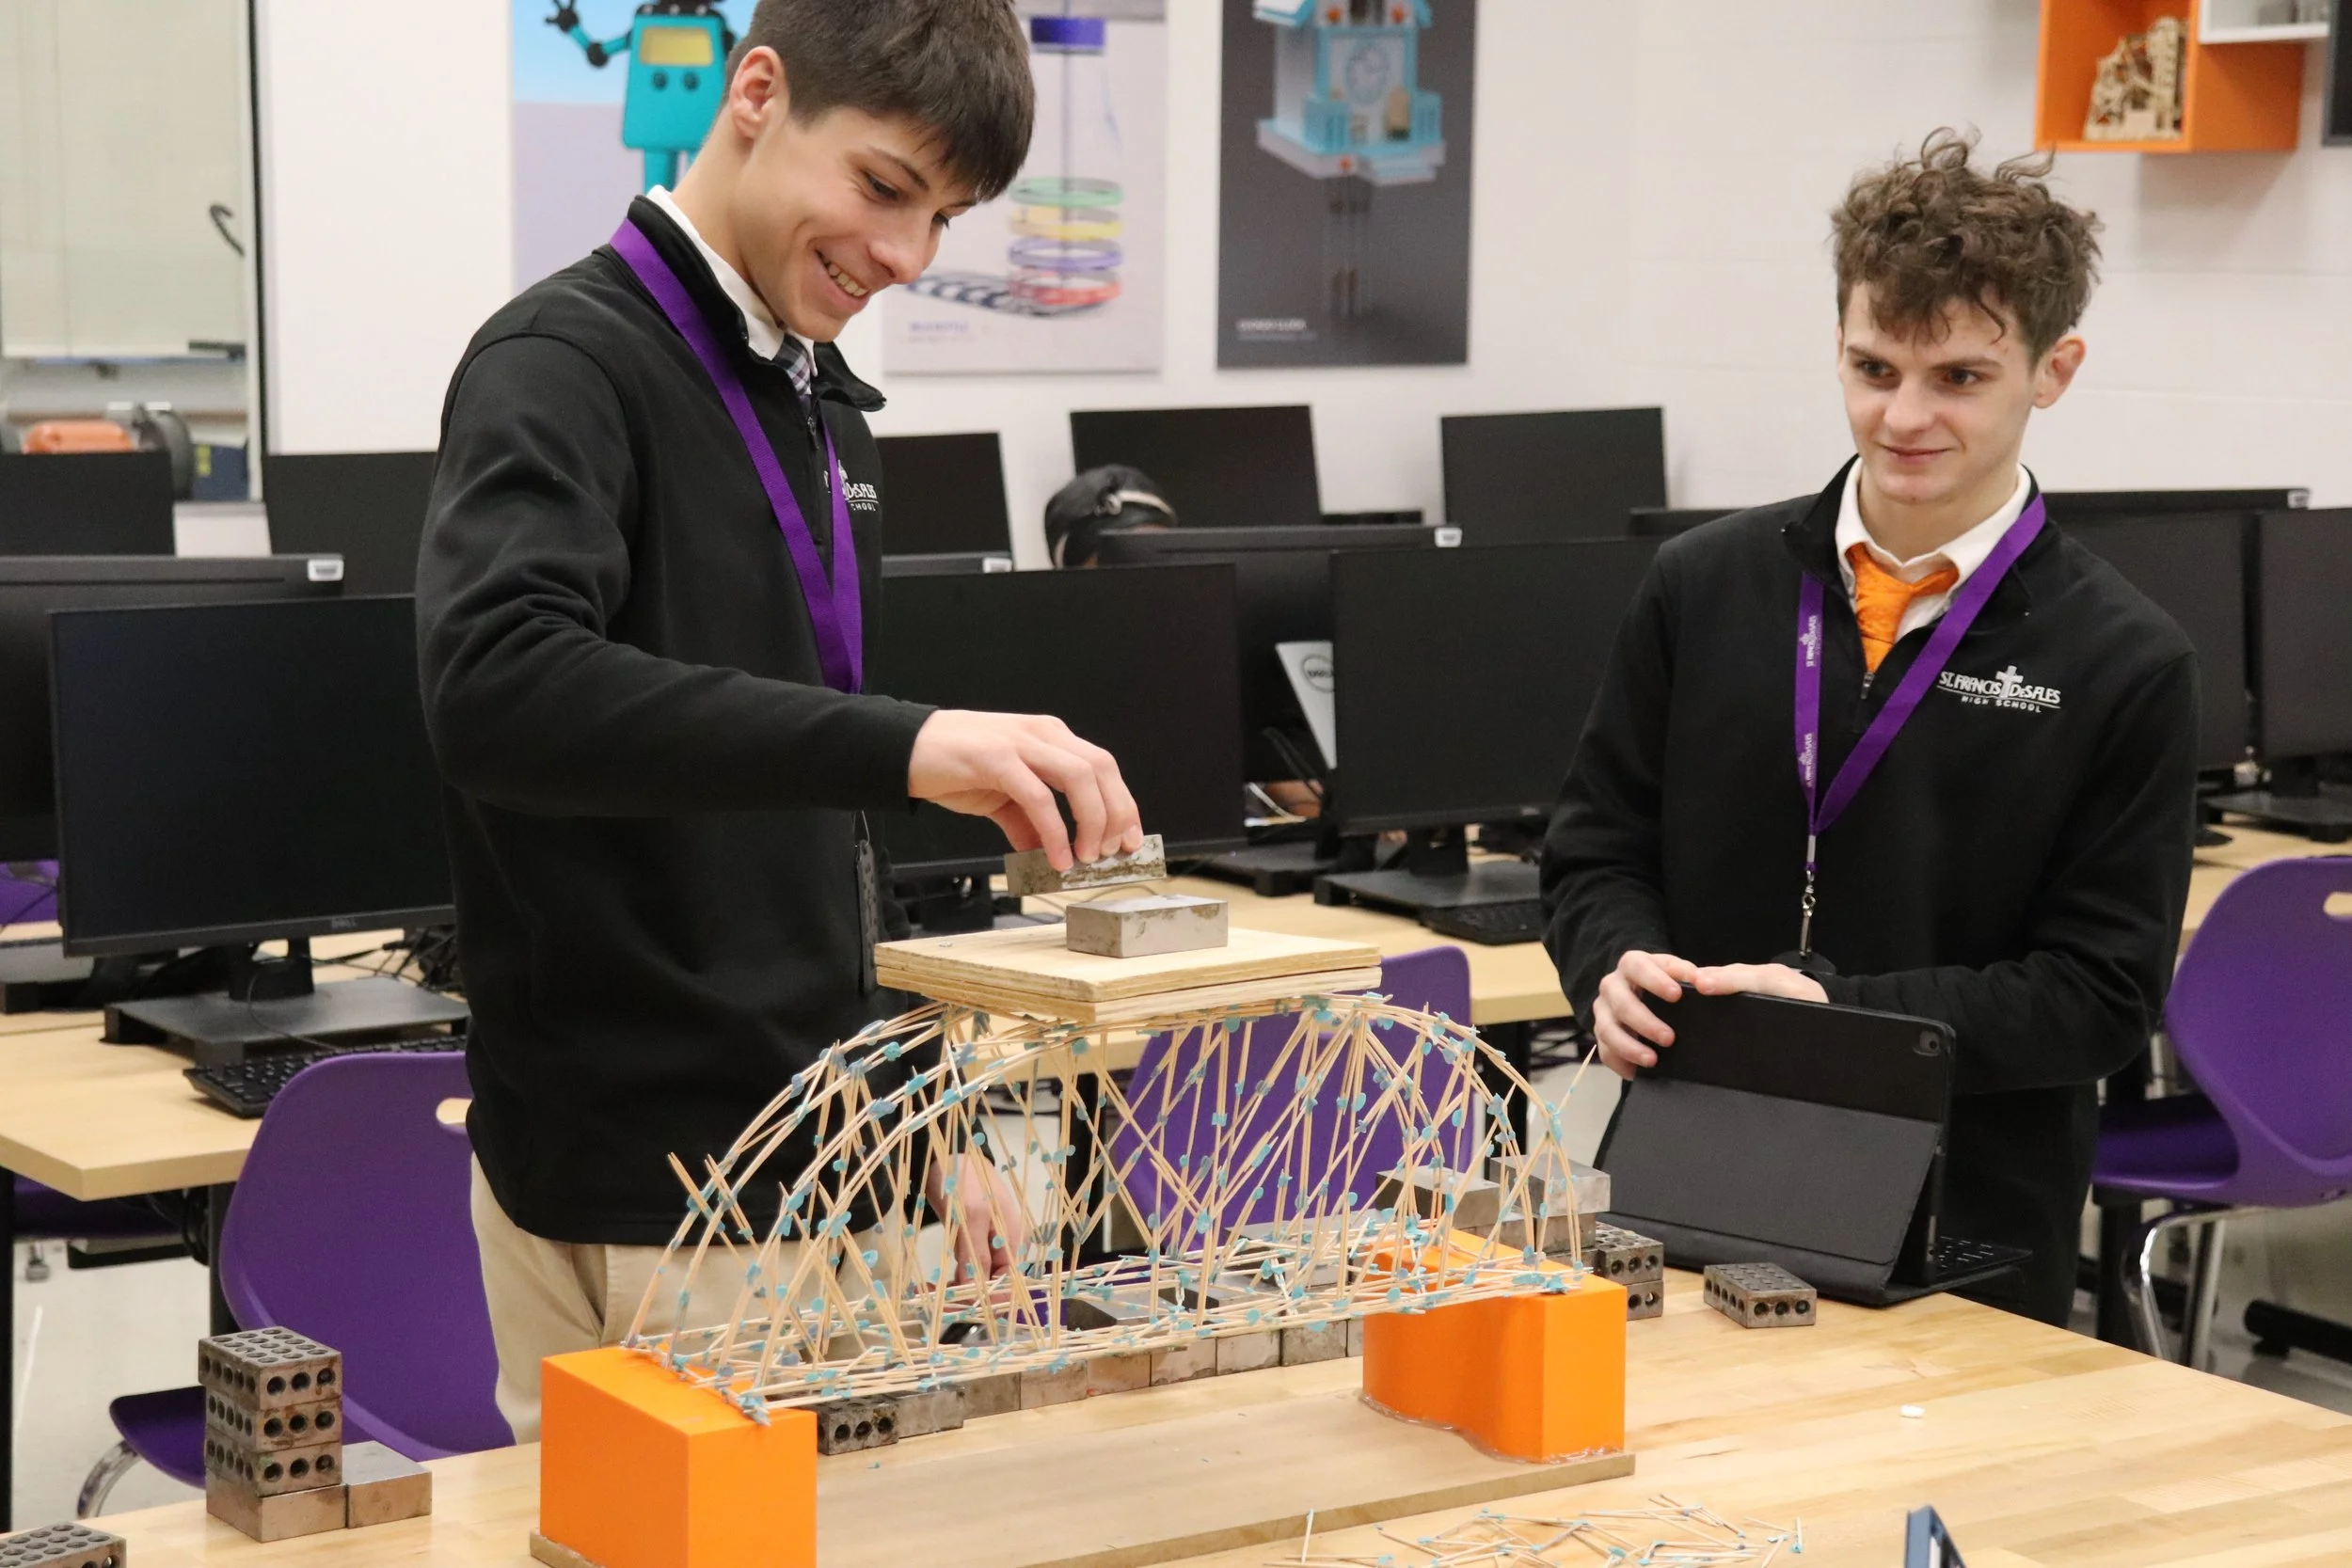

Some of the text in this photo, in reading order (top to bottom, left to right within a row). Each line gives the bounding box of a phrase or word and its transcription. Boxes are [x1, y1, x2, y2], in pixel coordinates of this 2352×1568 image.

[1939, 671, 1955, 688] ST.
[1953, 673, 2002, 695] FRANCIS
[1961, 696, 2042, 713] HIGH SCHOOL
